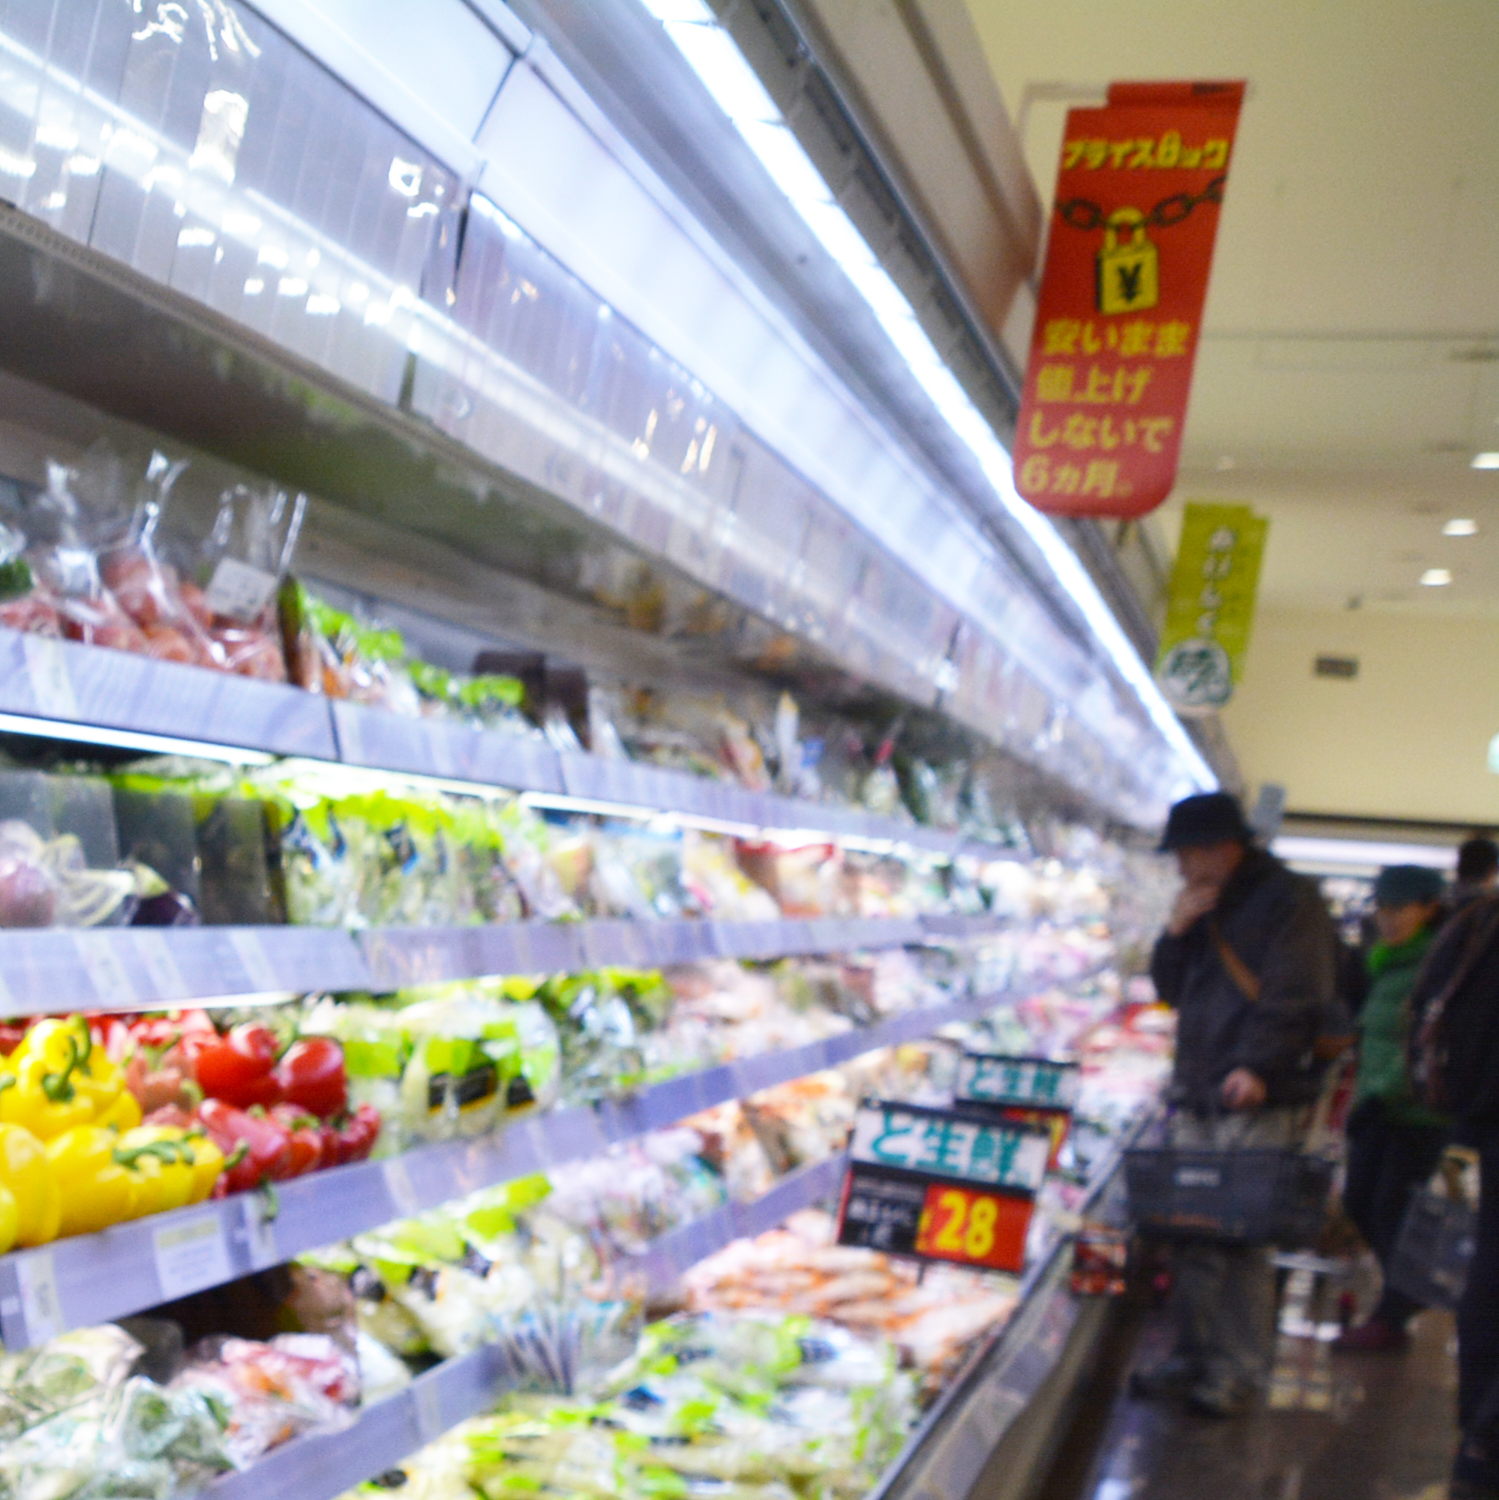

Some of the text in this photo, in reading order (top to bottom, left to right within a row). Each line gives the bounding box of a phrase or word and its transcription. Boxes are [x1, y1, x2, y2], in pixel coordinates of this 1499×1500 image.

[1028, 409, 1174, 455] しないで
[934, 1189, 999, 1259] 28
